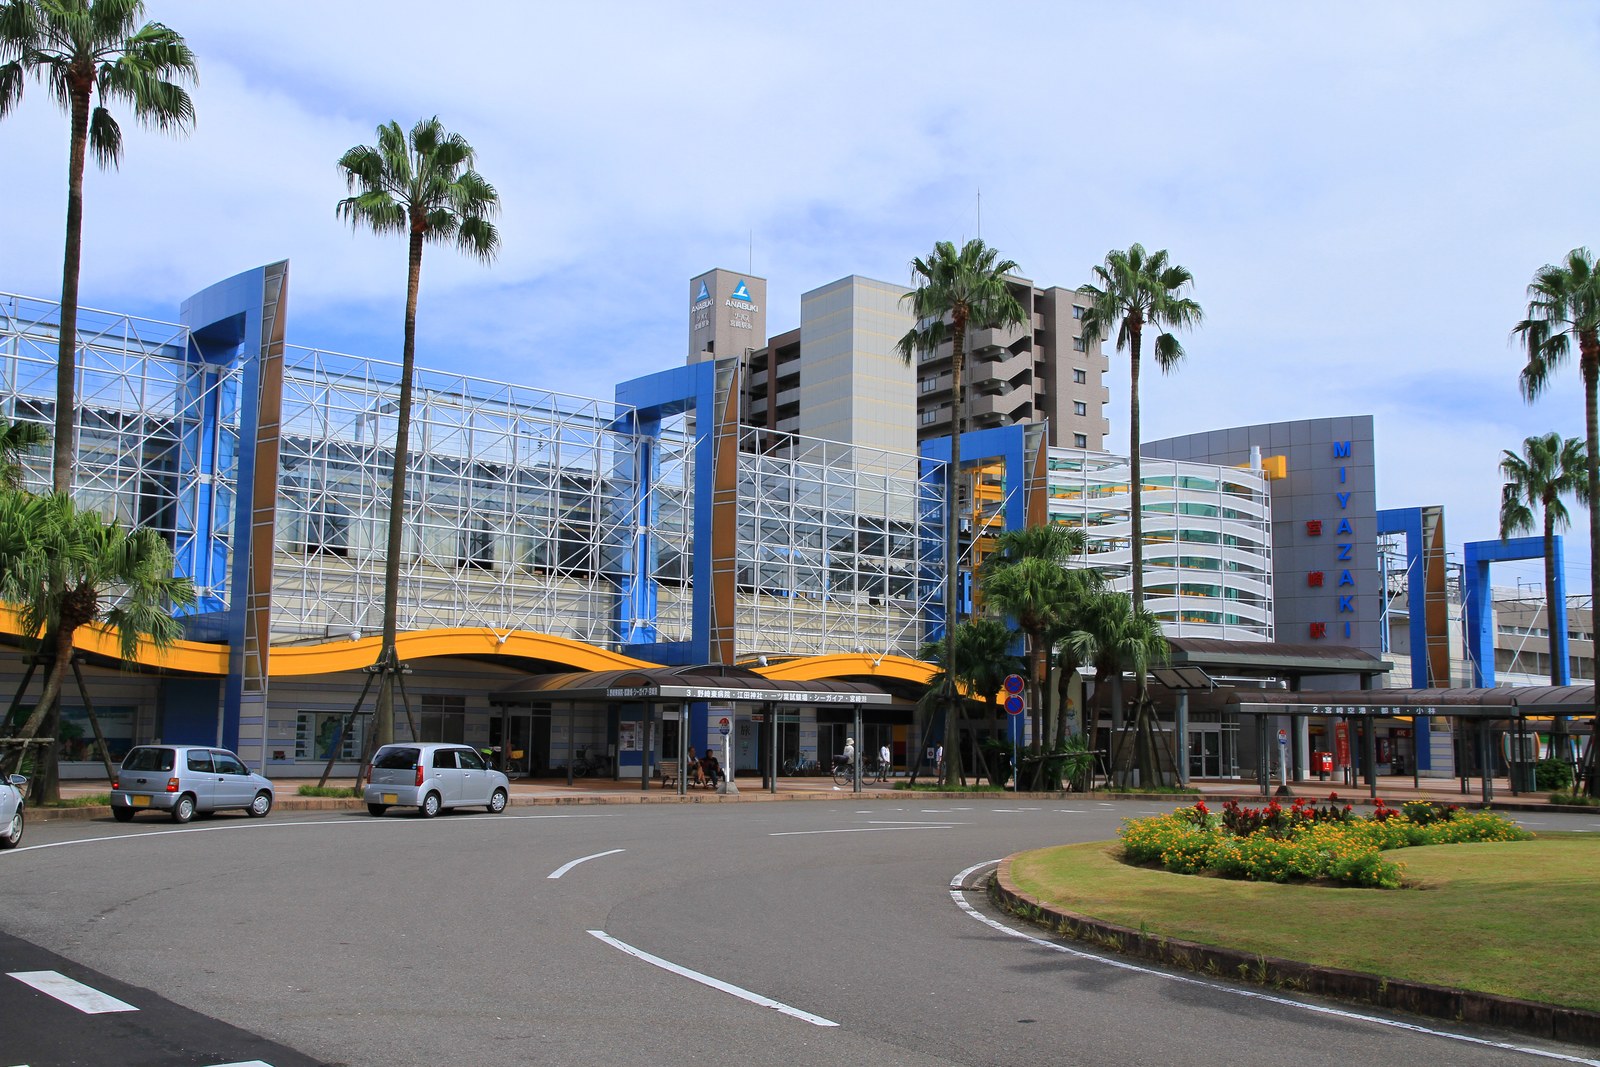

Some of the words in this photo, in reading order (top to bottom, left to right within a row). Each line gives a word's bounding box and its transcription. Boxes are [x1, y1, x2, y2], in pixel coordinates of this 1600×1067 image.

[691, 298, 714, 313] ANABUKI
[725, 299, 759, 313] ANABUKI
[1333, 440, 1354, 638] MIYAZAKI
[1306, 519, 1327, 639] 宮崎駅
